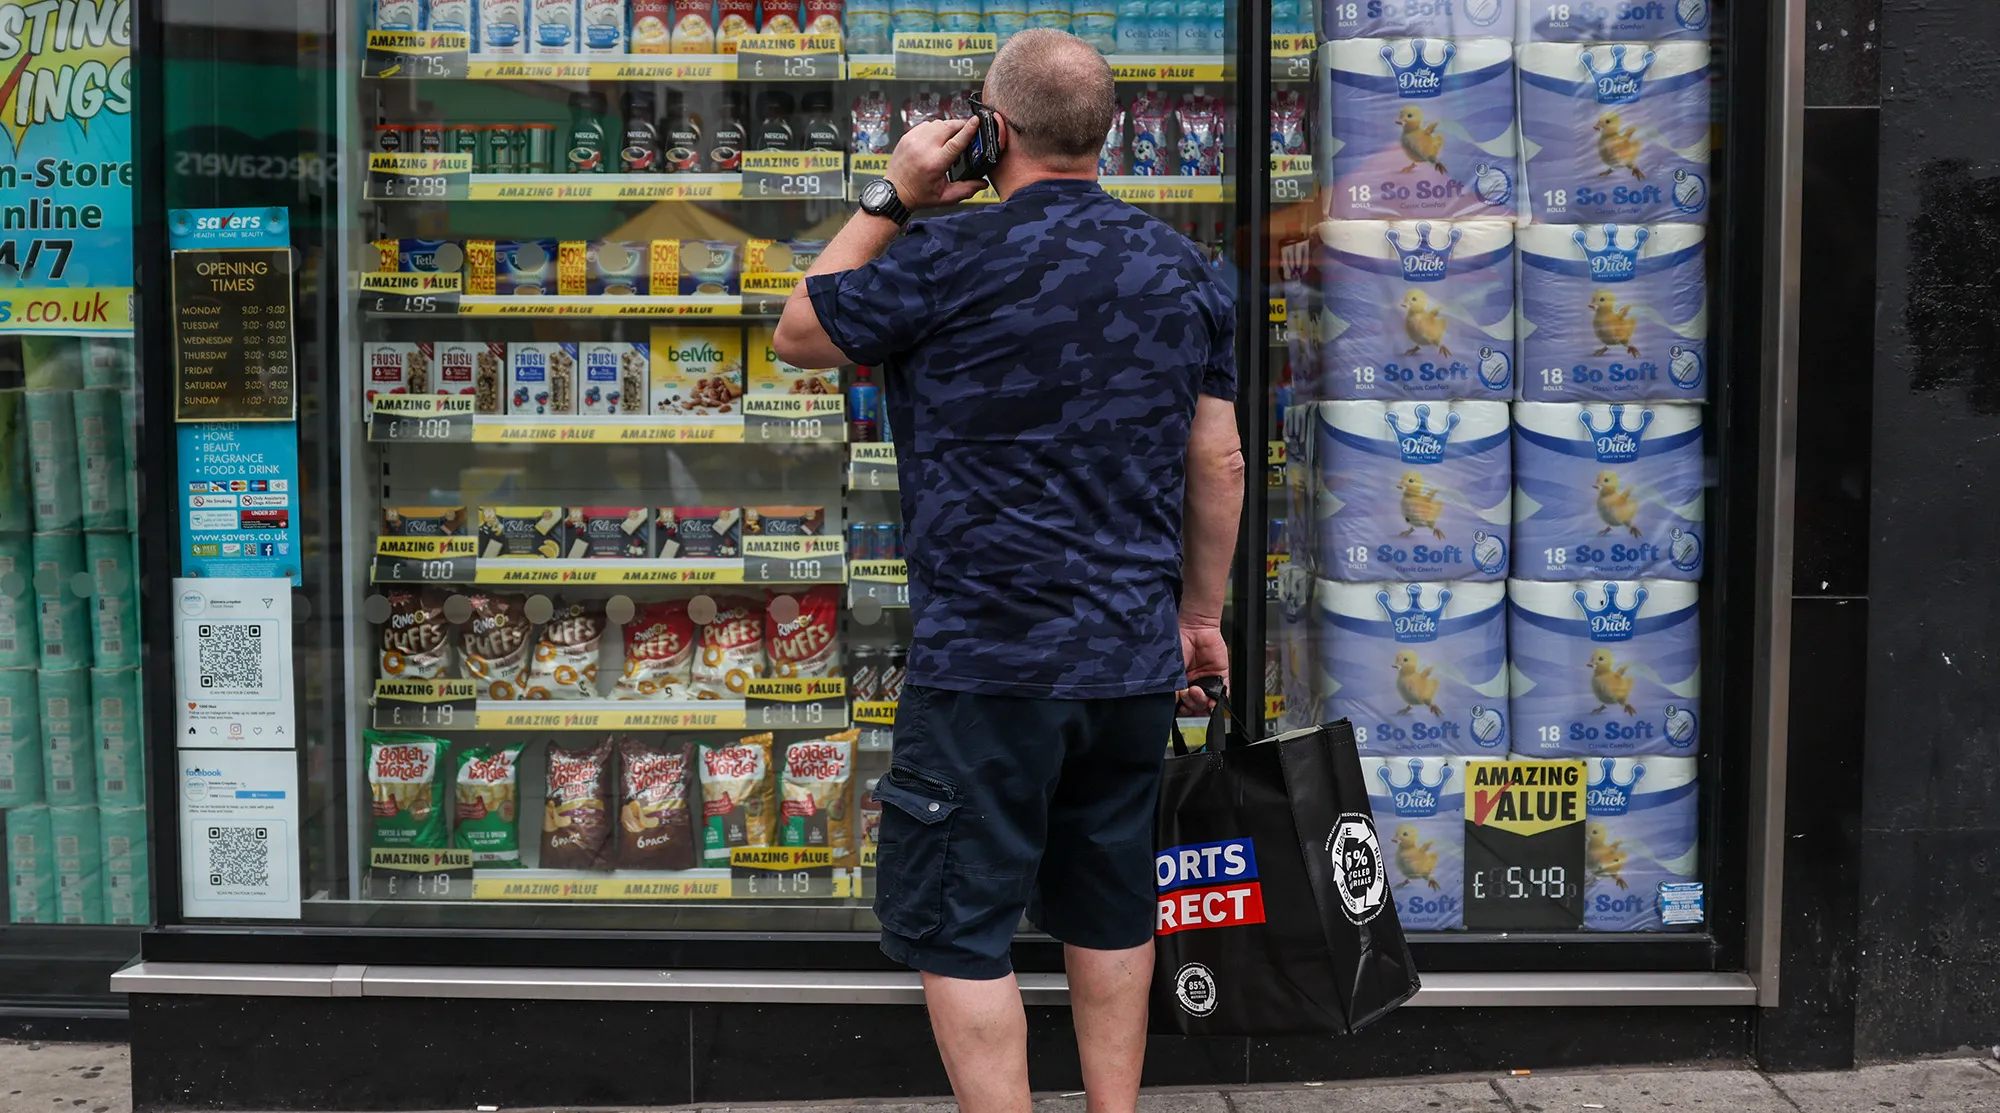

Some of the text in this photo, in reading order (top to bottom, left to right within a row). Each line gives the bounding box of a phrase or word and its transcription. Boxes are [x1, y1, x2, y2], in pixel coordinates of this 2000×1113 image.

[370, 34, 466, 48] AMAZING VALUE
[740, 37, 836, 50] AMAZING VALUE
[898, 36, 992, 50] AMAZING VALUE
[496, 64, 592, 77] AMAZING VALUE
[1400, 72, 1440, 88] Duck
[0, 53, 131, 127] INGS
[372, 156, 467, 171] AMAZING VALUE
[745, 154, 839, 169] AMAZING VALUE
[498, 184, 592, 197] AMAZING VALUE
[1348, 185, 1371, 201] 18
[1380, 180, 1465, 200] So Soft
[196, 212, 260, 230] savers
[470, 249, 494, 266] 50%
[1404, 255, 1445, 272] Duck
[196, 262, 268, 275] OPENING
[471, 266, 494, 275] EXTRA
[211, 279, 255, 292] TIMES
[363, 274, 458, 289] AMAZING VALUE
[470, 276, 494, 290] FREE
[182, 307, 221, 315] MONDAY
[668, 342, 723, 362] belVita
[1353, 366, 1374, 382] 18
[1384, 362, 1469, 382] So Soft
[376, 397, 471, 412] AMAZING VALUE
[746, 397, 841, 412] AMAZING VALUE
[203, 422, 239, 430] HEALTH
[621, 426, 714, 439] AMAZING VALUE
[203, 432, 234, 441] HOME
[204, 443, 240, 452] BEAUTY
[1597, 438, 1637, 453] Duck
[204, 454, 263, 463] FRAGRANCE
[204, 465, 279, 475] FOOD & DRINK
[505, 520, 535, 534] Bliss
[192, 530, 288, 541] www.savers.co.uk
[380, 539, 474, 554] AMAZING VALUE
[746, 538, 840, 554] AMAZING VALUE
[1576, 543, 1660, 563] So Soft
[1544, 547, 1566, 564] 18
[1591, 615, 1632, 632] Duck
[384, 623, 442, 649] PUFFS
[773, 622, 831, 658] PUFFS
[378, 681, 473, 697] AMAZING VALUE
[748, 680, 842, 695] AMAZING VALUE
[1538, 726, 1560, 741] 18
[1569, 720, 1654, 741] So Soft
[378, 744, 429, 765] Golden
[788, 744, 844, 762] Golden
[376, 761, 428, 782] Wonder
[788, 759, 844, 780] Wonder
[1475, 767, 1579, 786] AMAZING
[1475, 779, 1577, 826] VALUE
[374, 850, 470, 866] AMAZING VALUE
[734, 848, 829, 864] AMAZING VALUE
[624, 881, 719, 895] AMAZING VALUE
[1472, 866, 1565, 899] £ 5.49
[1189, 980, 1205, 990] 85%
